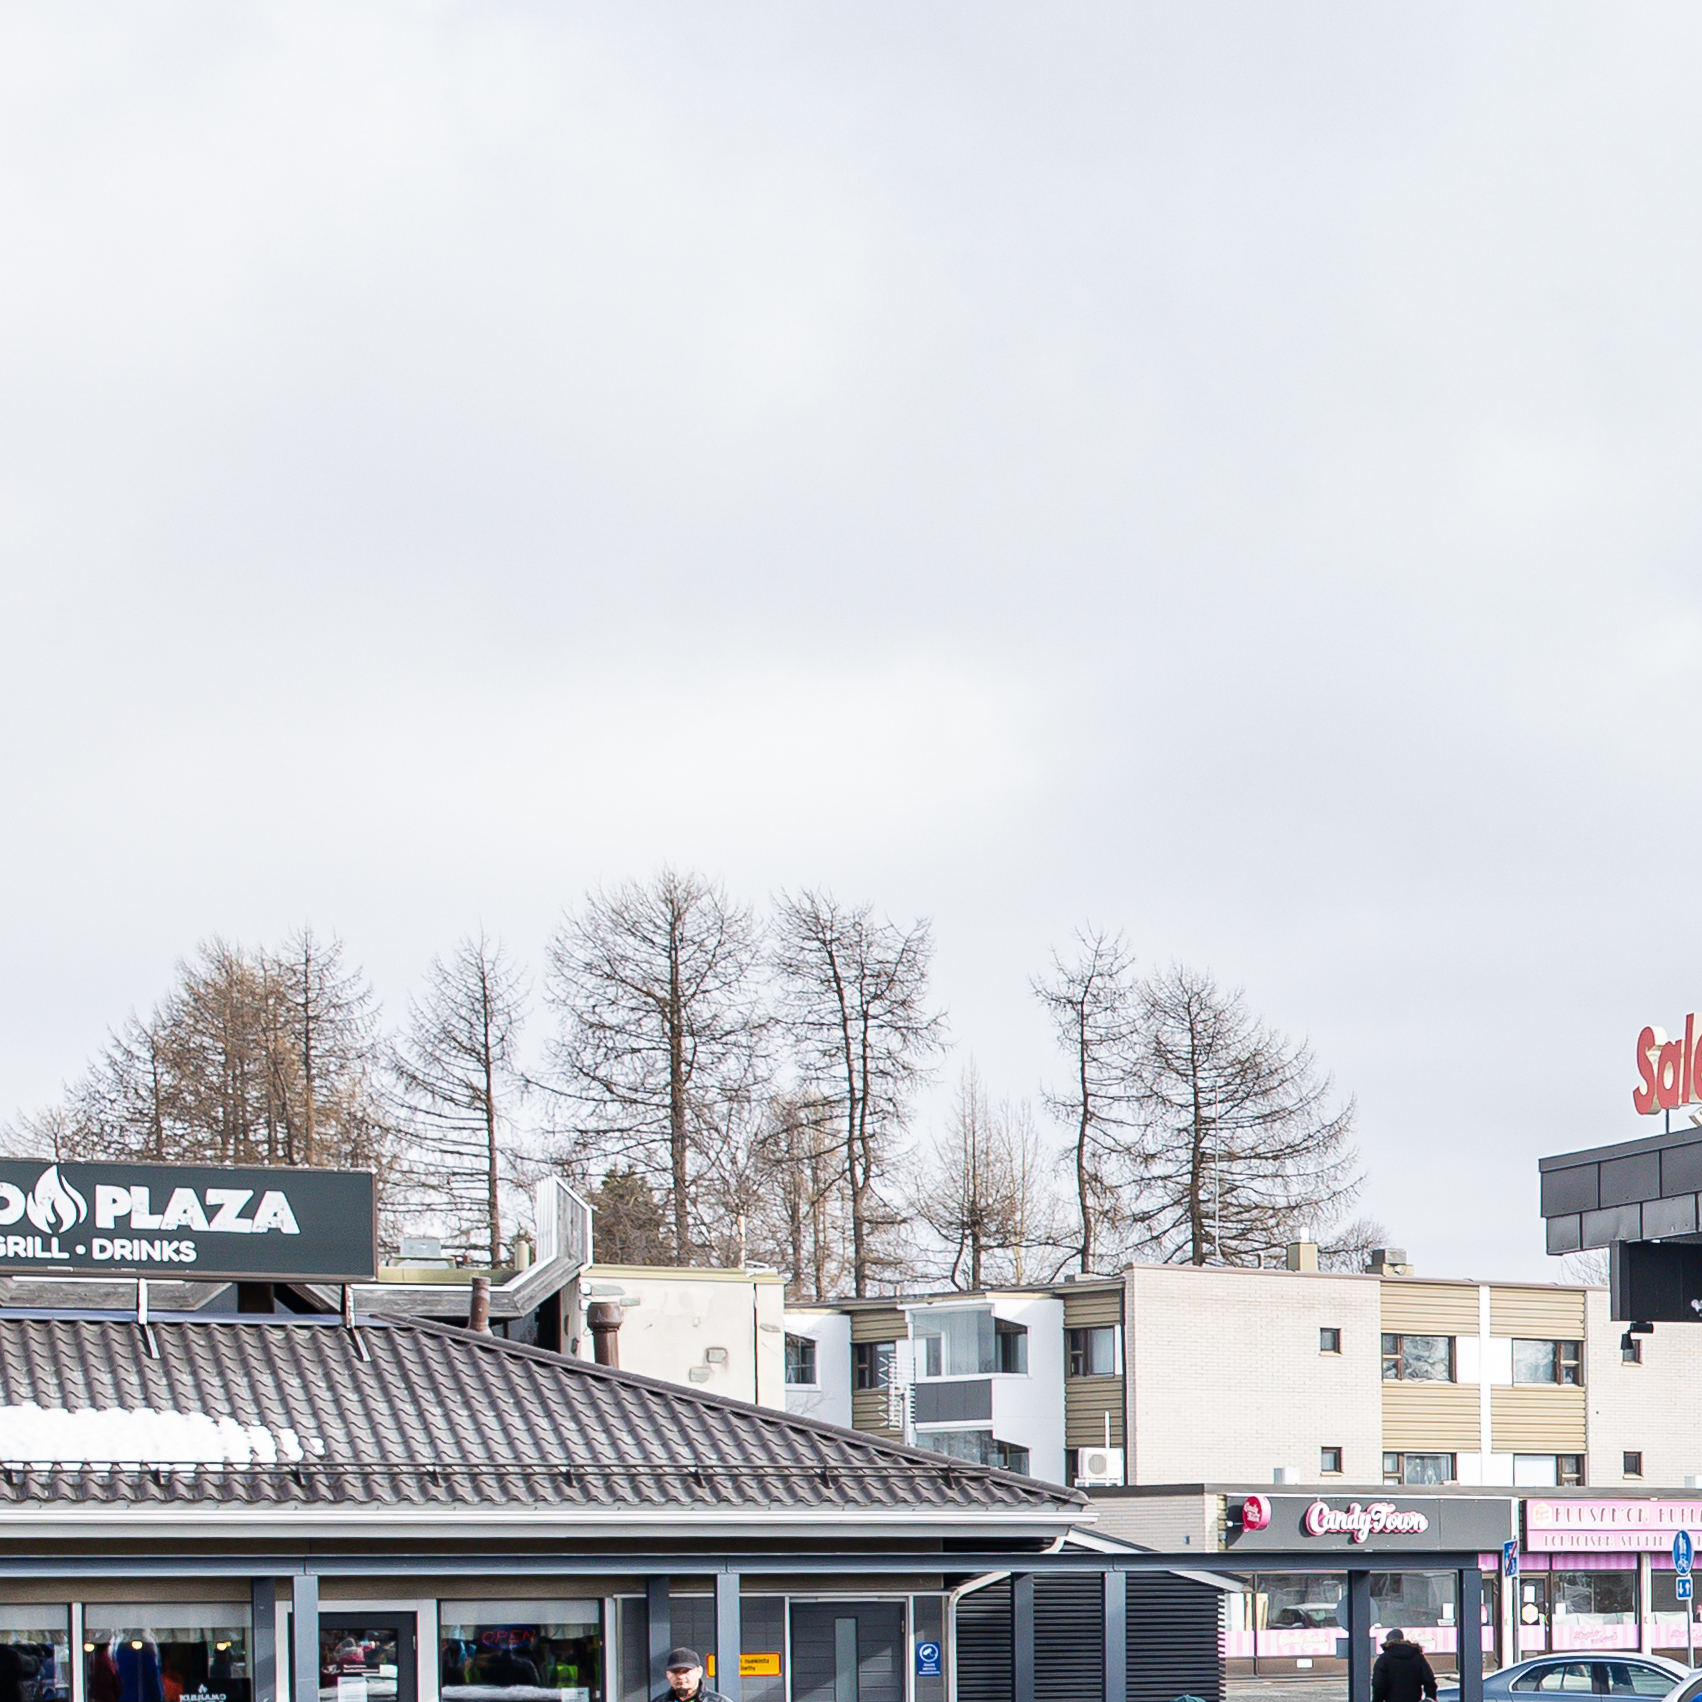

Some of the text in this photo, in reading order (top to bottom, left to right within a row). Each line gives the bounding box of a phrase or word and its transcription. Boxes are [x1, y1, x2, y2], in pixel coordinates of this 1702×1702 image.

[95, 1184, 301, 1235] PLAZA
[92, 1238, 197, 1262] DRINKS
[482, 1629, 536, 1645] OPEN
